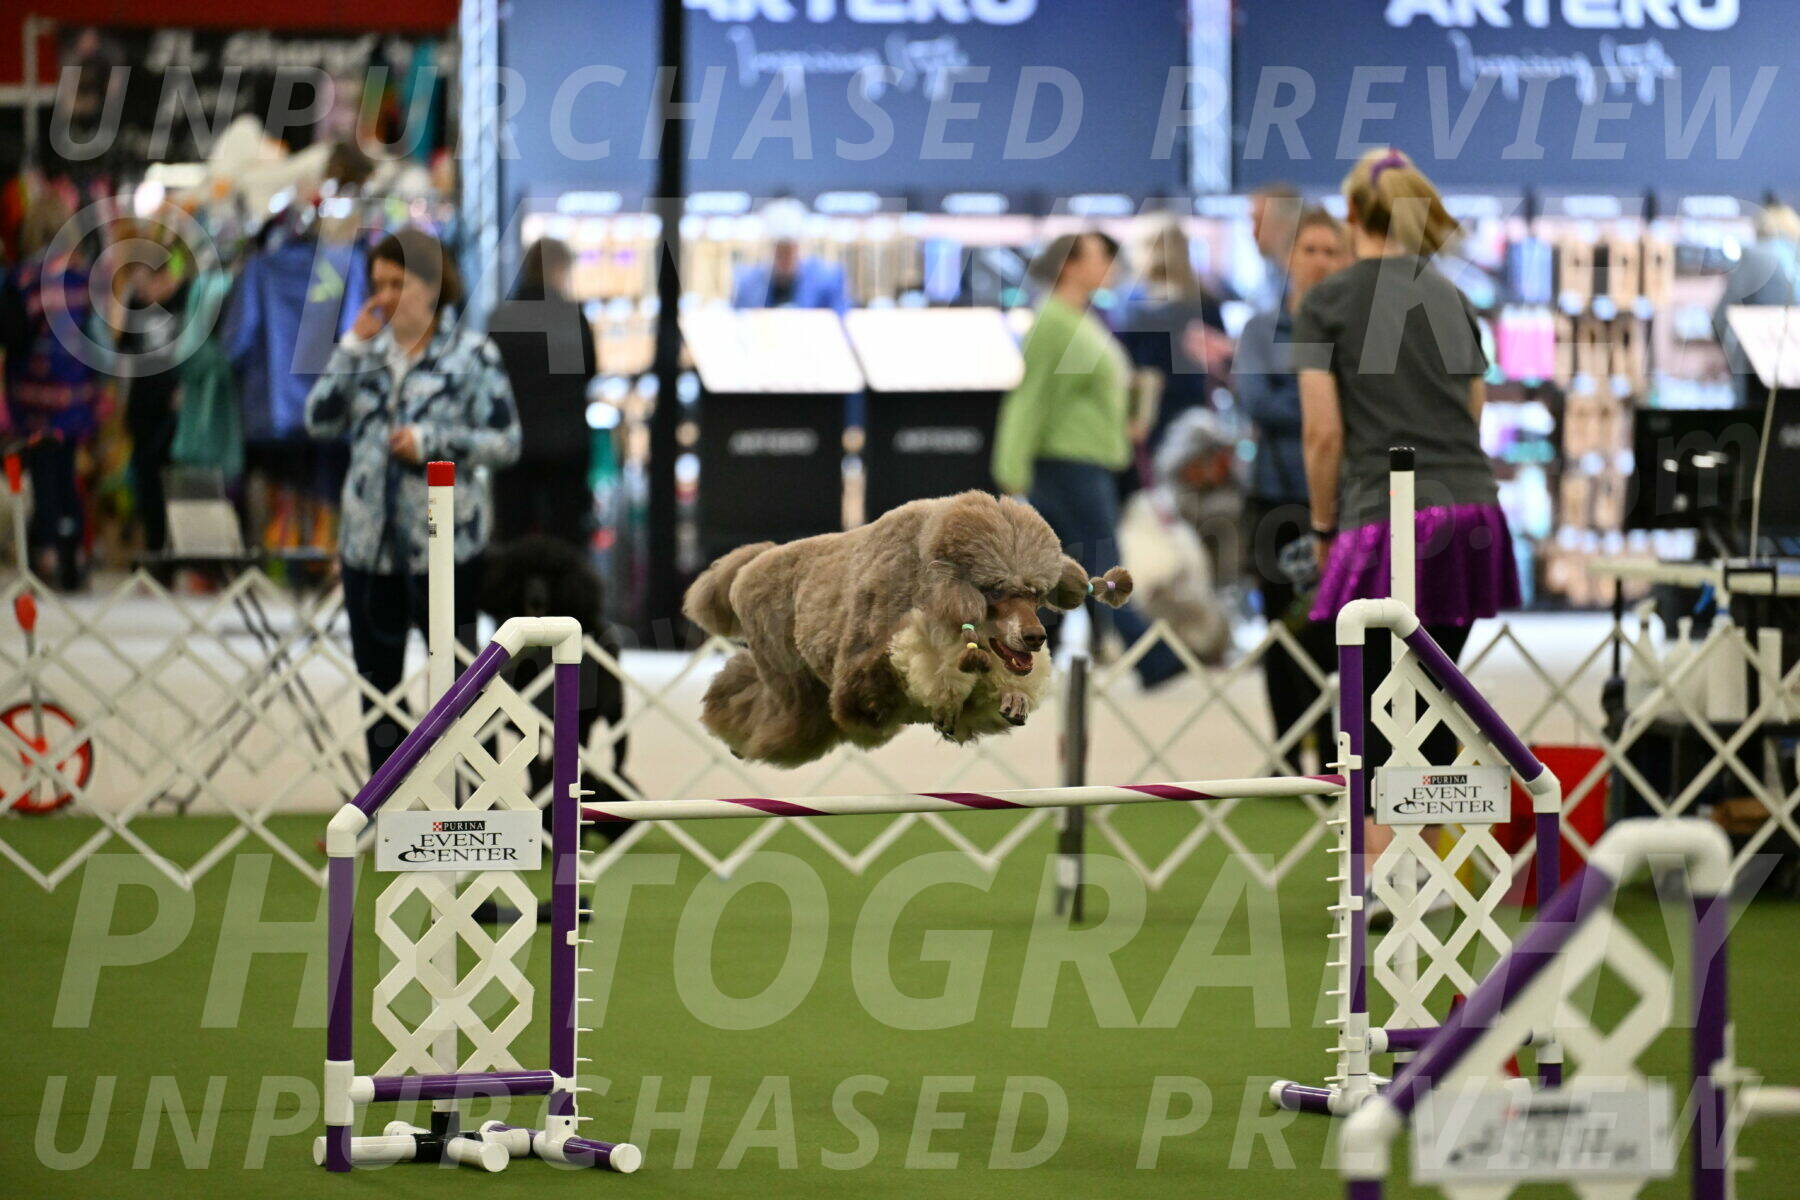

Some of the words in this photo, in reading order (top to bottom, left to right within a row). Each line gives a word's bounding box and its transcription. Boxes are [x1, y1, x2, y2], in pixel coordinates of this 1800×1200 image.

[1431, 775, 1467, 784] PURINA
[1412, 786, 1482, 800] EVENT
[1393, 800, 1496, 814] CENTER
[443, 821, 485, 831] PURINA
[421, 833, 502, 847] EVENT
[398, 847, 518, 862] CENTER
